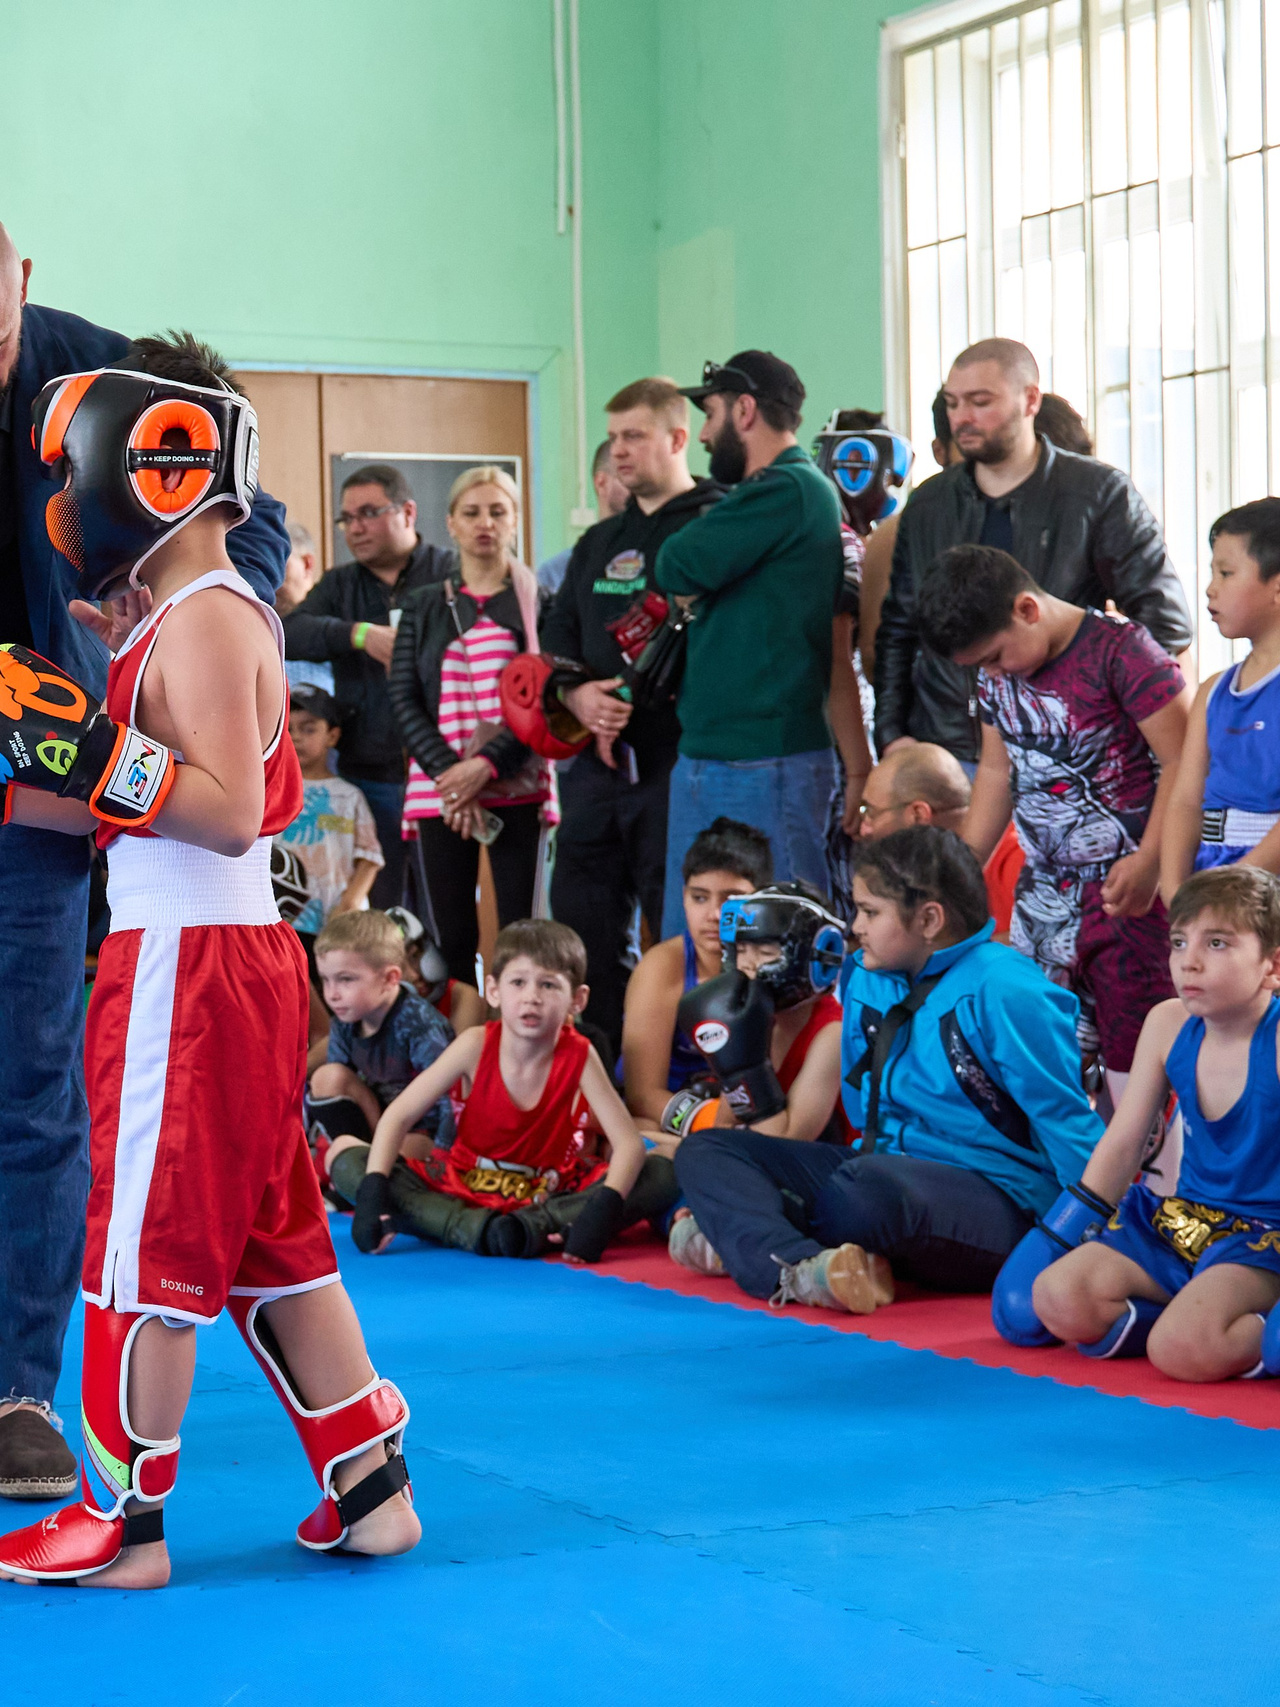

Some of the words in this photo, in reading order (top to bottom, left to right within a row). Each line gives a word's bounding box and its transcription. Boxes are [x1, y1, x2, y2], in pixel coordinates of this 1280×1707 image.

[8, 739, 22, 759] SPORT
[12, 730, 27, 752] DOING
[160, 1278, 204, 1296] BOXING
